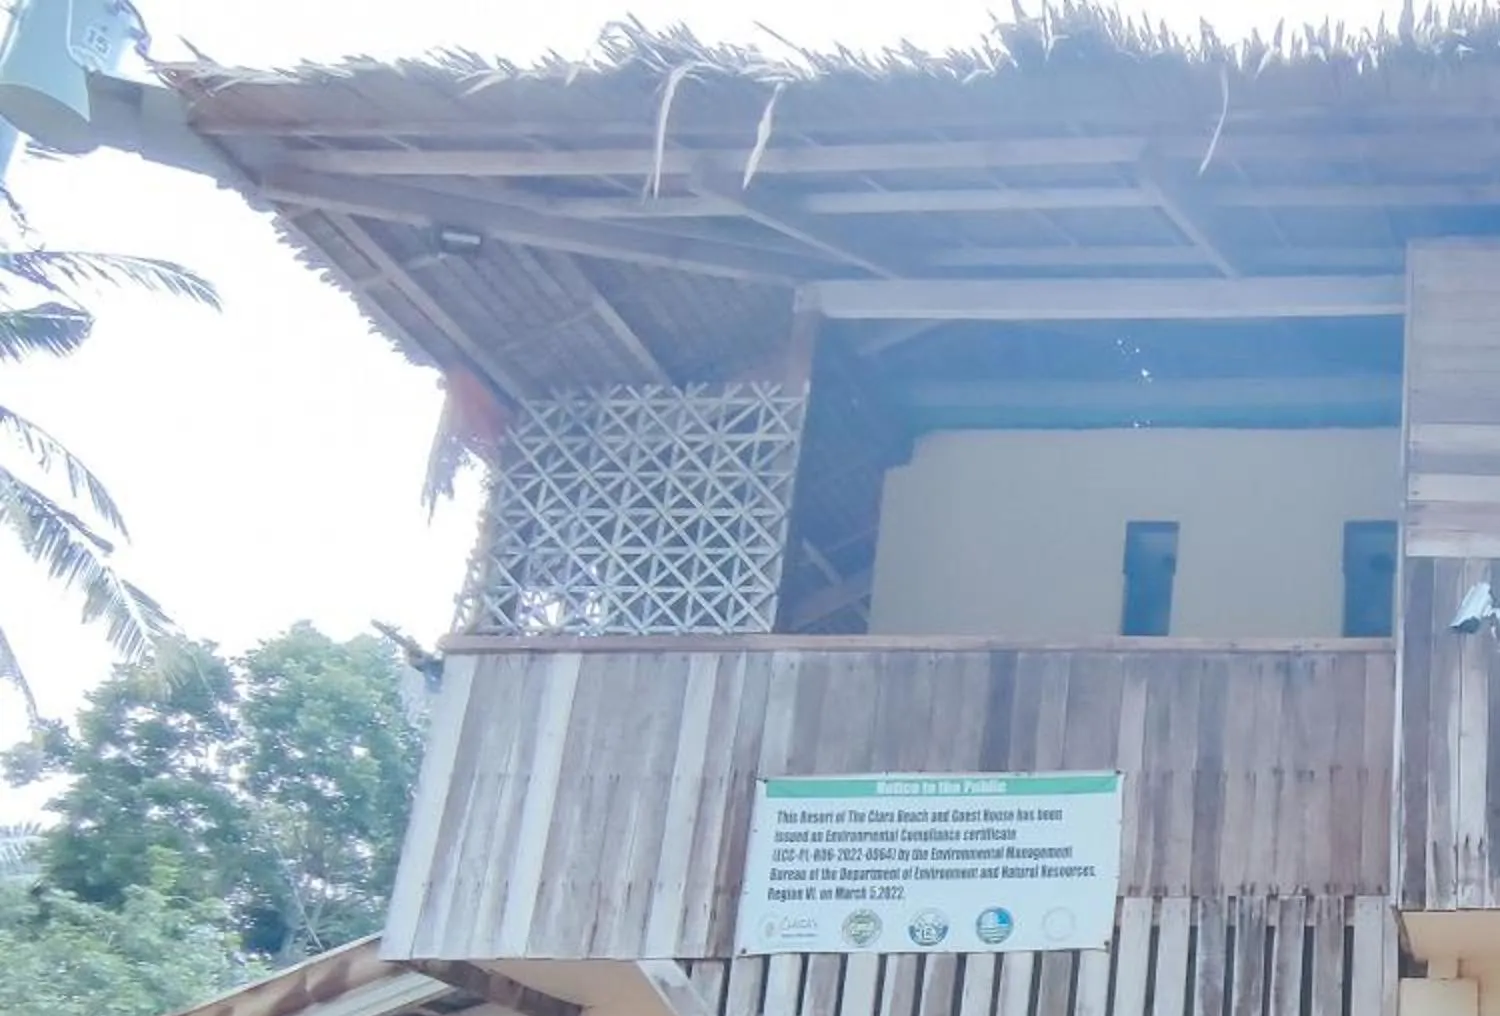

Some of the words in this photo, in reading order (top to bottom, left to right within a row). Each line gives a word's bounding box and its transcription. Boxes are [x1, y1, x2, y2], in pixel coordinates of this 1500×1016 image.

[876, 781, 920, 795] Notice
[922, 781, 936, 795] to
[938, 780, 962, 794] the
[964, 779, 1007, 794] Public
[777, 810, 797, 824] This
[800, 810, 833, 824] Resort
[836, 810, 845, 824] of
[848, 810, 866, 823] The
[868, 809, 894, 823] Clara
[898, 809, 929, 823] Beach
[931, 809, 950, 822] and
[952, 809, 981, 822] Guest
[984, 808, 1014, 822] House
[1016, 808, 1035, 821] has
[1037, 808, 1063, 821] been
[811, 831, 823, 843] an
[826, 829, 898, 843] Environmental
[901, 828, 960, 842] Compliance
[963, 828, 1017, 841] certificate
[898, 848, 911, 861] by
[912, 848, 929, 861] the
[930, 846, 1005, 861] Environmental
[1006, 846, 1073, 861] Management
[769, 867, 806, 881] Bureau
[809, 868, 819, 881] of
[821, 868, 837, 880] the
[839, 867, 900, 882] Department
[902, 867, 913, 880] of
[914, 866, 979, 880] Environment
[980, 866, 999, 879] and
[1001, 865, 1039, 879] Natural
[767, 887, 803, 903] Region
[819, 888, 833, 900] on
[834, 886, 867, 900] March
